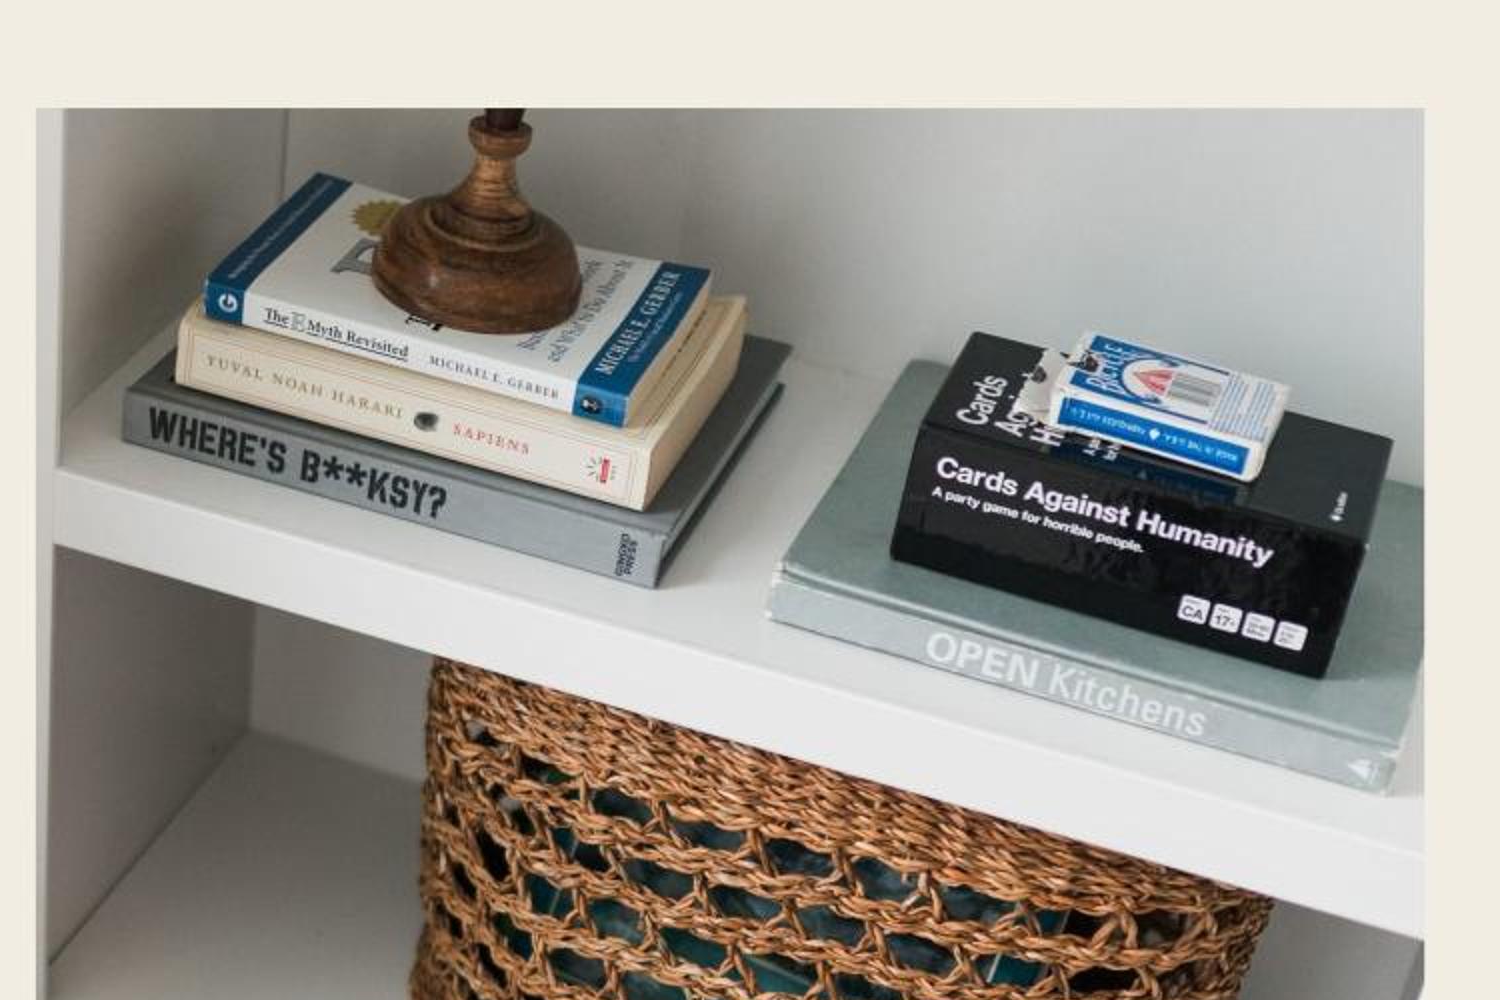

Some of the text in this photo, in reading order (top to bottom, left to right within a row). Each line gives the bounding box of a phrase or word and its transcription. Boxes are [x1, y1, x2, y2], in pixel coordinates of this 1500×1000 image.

[264, 307, 289, 324] The
[308, 319, 342, 342] Myth
[347, 331, 409, 357] Revisited
[595, 325, 642, 376] MICHAEL
[642, 269, 681, 317] GERBER
[207, 353, 403, 418] YUVAL NOAH HARARI
[429, 355, 490, 381] MICHAEL
[507, 376, 560, 401] GERBER
[956, 374, 1008, 426] Cards
[149, 406, 287, 475] WHERE'S
[453, 422, 530, 455] SAPIENS
[931, 486, 1144, 554] A party game for horrible people.
[936, 456, 1275, 569] Cards Against Humanity
[1180, 604, 1204, 622] CA
[926, 631, 1207, 737] OPEN Kitchens
